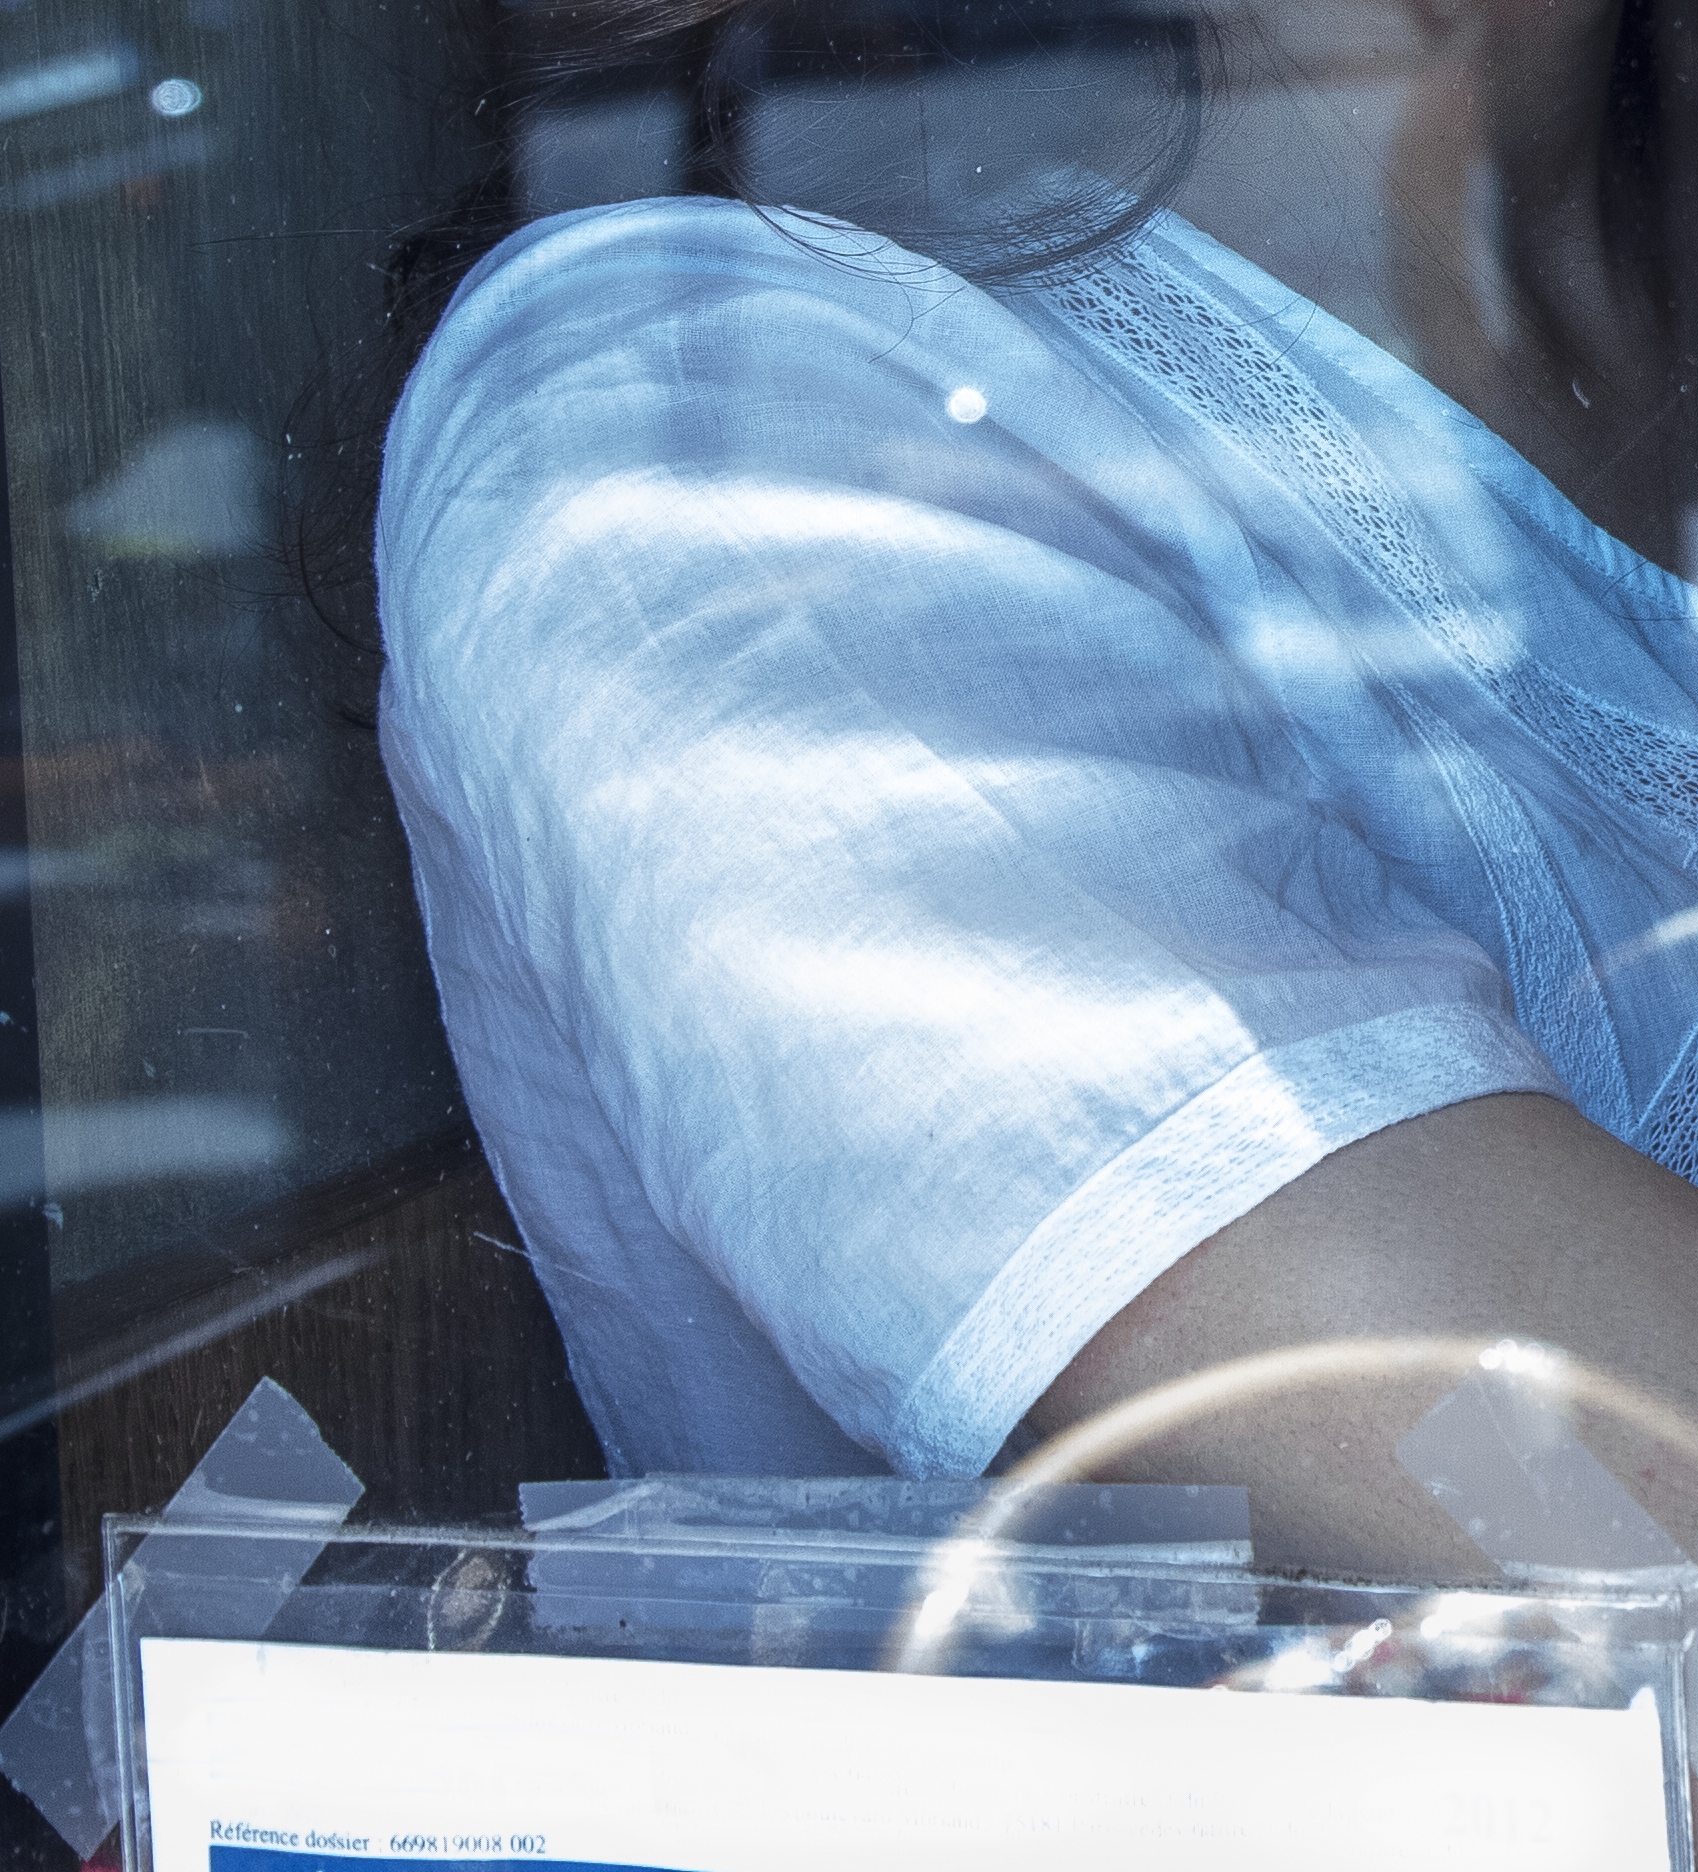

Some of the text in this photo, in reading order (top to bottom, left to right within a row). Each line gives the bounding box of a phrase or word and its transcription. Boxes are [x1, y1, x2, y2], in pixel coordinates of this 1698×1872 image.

[209, 1819, 299, 1847] Référence
[305, 1829, 369, 1851] dossier
[389, 1834, 502, 1853] 669819008
[510, 1834, 546, 1854] 002
